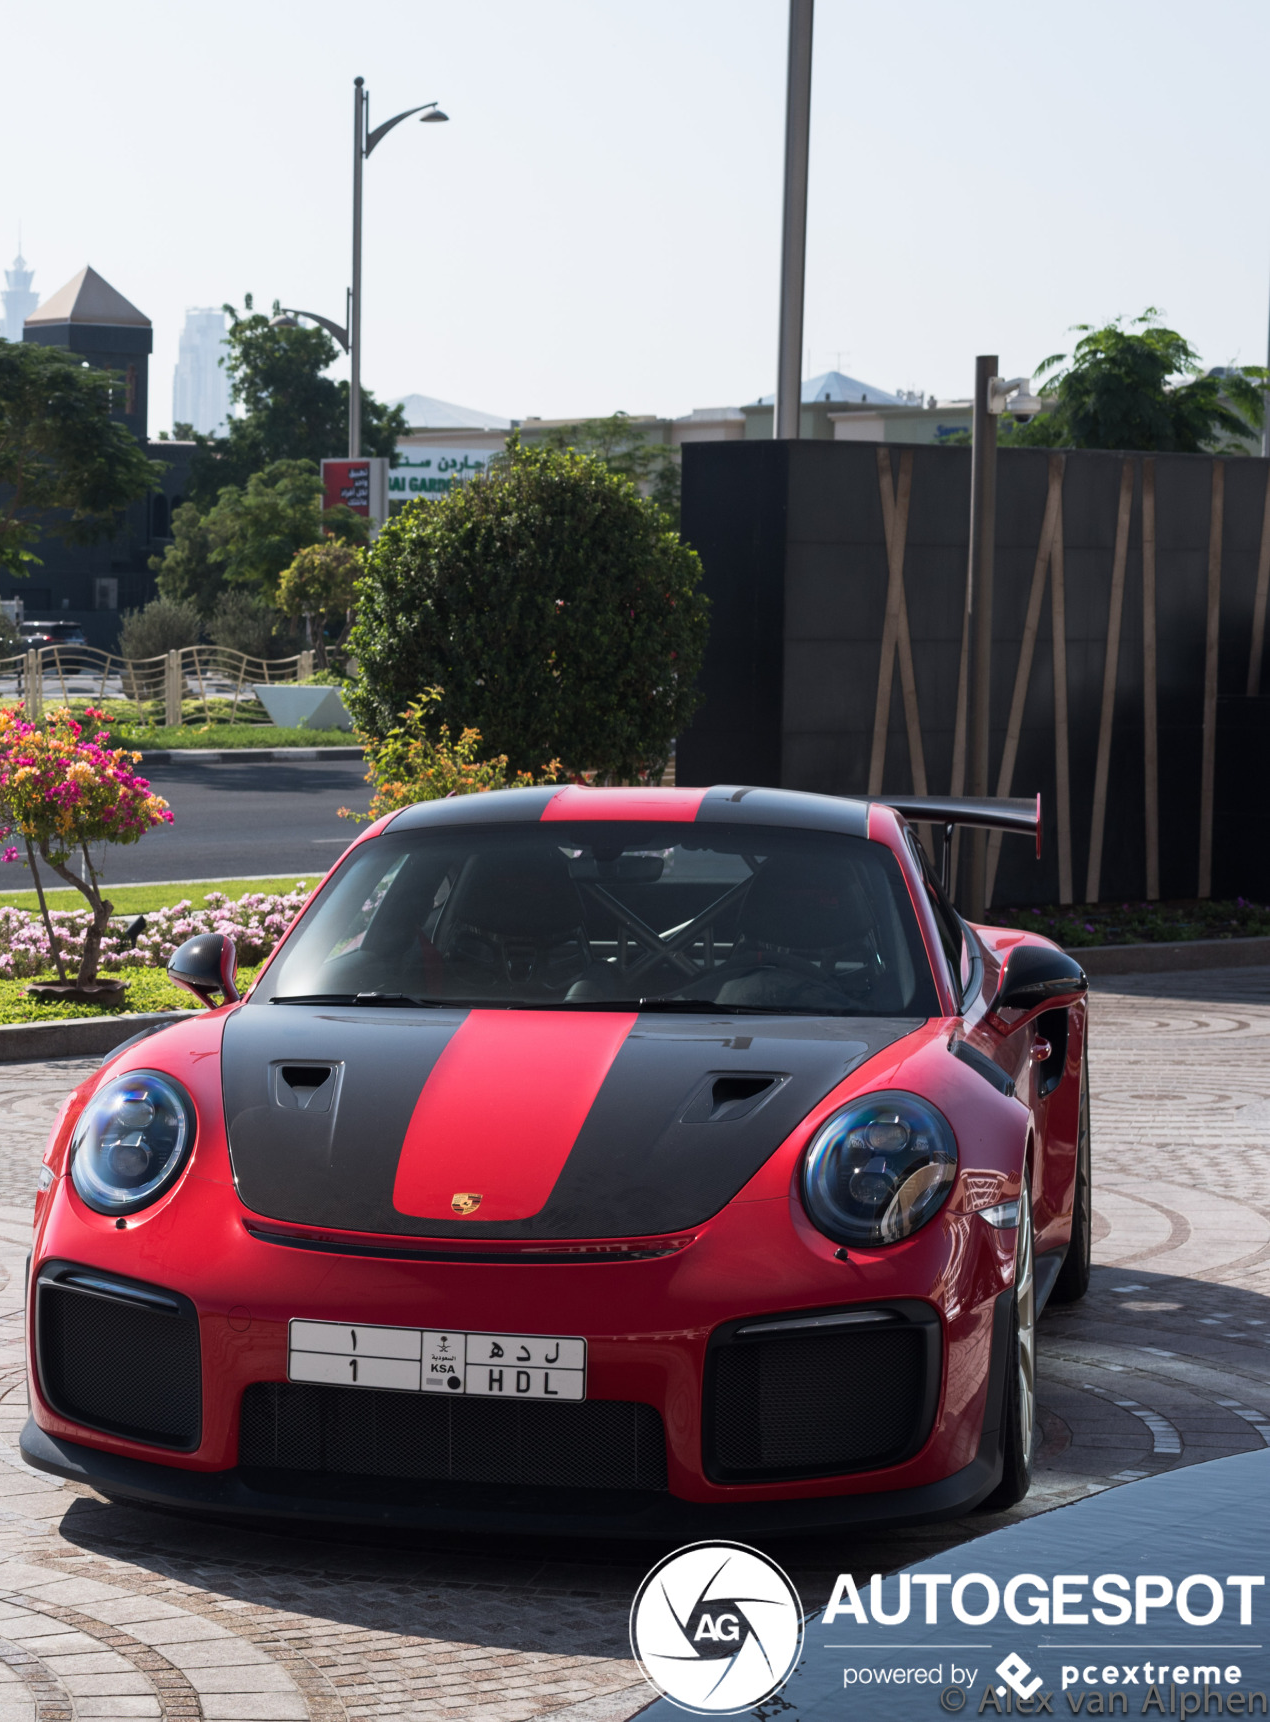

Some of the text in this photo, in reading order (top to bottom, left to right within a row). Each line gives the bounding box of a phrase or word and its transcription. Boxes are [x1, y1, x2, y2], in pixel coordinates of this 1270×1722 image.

[431, 1353, 457, 1362] السعودية
[349, 1358, 358, 1382] 1
[430, 1363, 456, 1374] KSA
